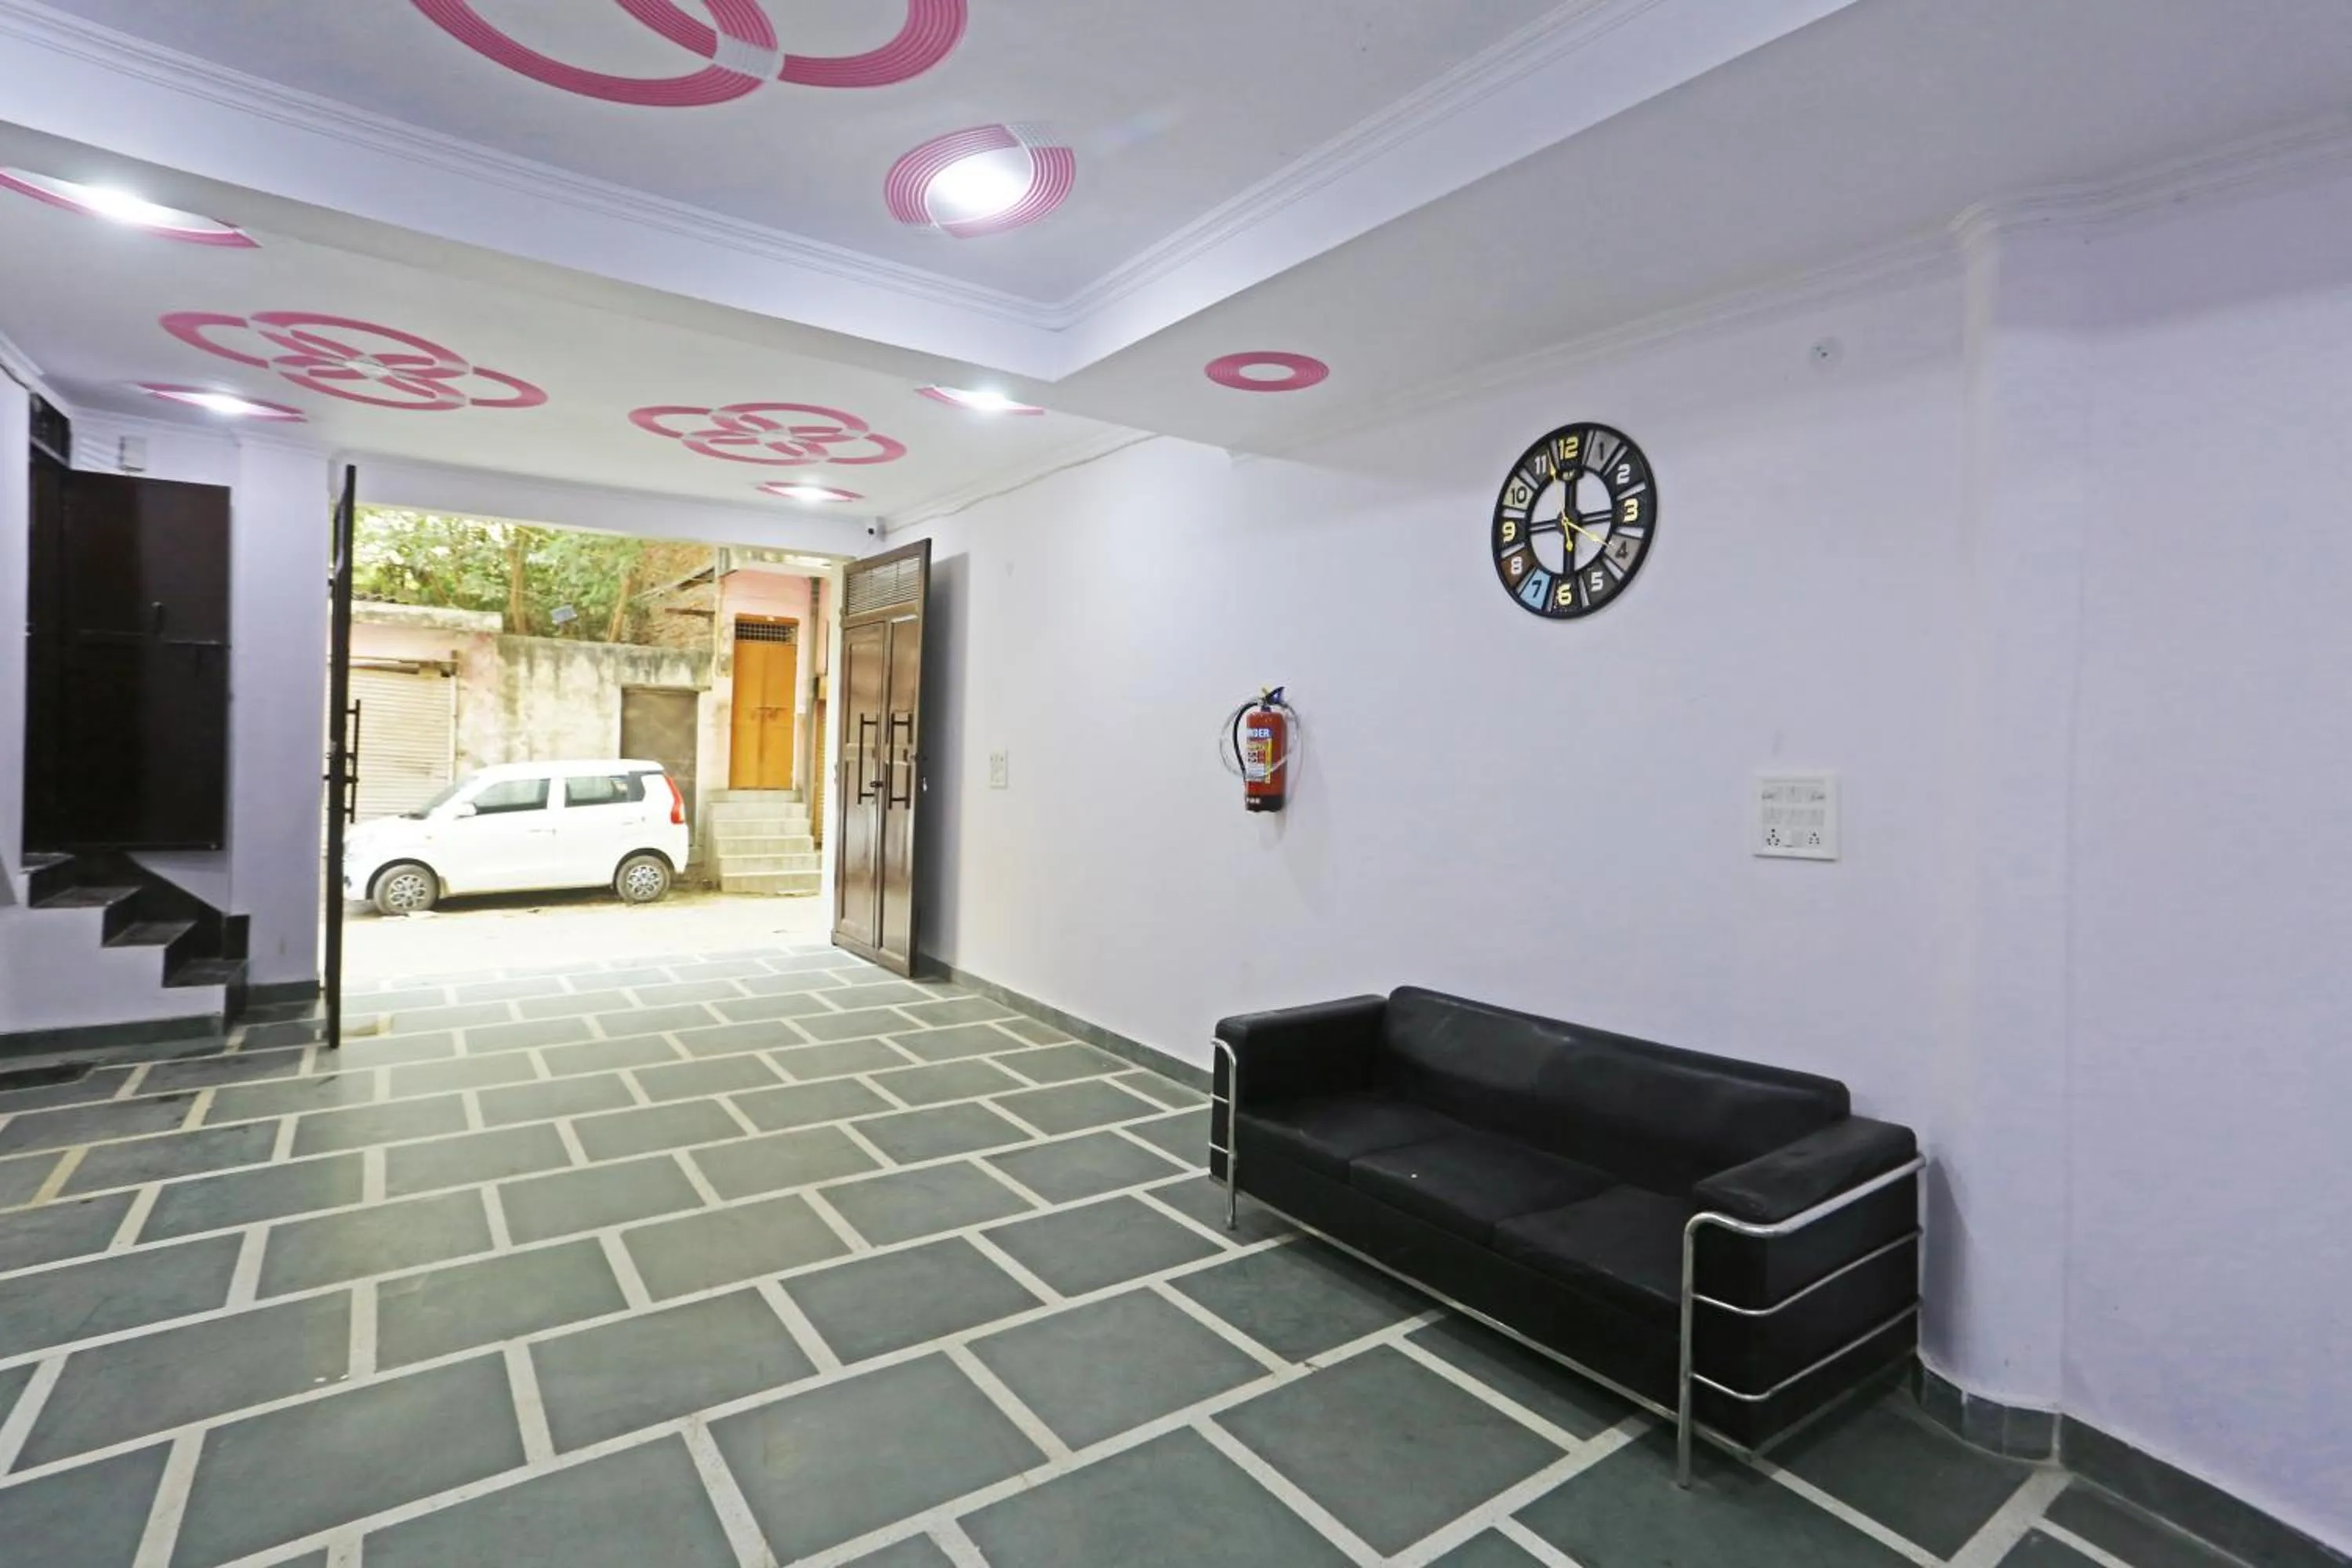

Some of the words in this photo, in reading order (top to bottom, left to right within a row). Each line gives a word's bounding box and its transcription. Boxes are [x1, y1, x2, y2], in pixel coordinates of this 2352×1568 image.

[1559, 436, 1579, 460] 12
[1599, 441, 1604, 461] 1
[1534, 455, 1547, 475] 11
[1617, 463, 1631, 485] 2
[1511, 486, 1527, 506] 10
[1623, 498, 1639, 524] 3
[1502, 521, 1516, 543] 9
[1616, 540, 1628, 559] 4
[1511, 556, 1523, 575] 8
[1532, 579, 1542, 598] 7
[1591, 571, 1603, 592] 5
[1558, 583, 1573, 606] 6
